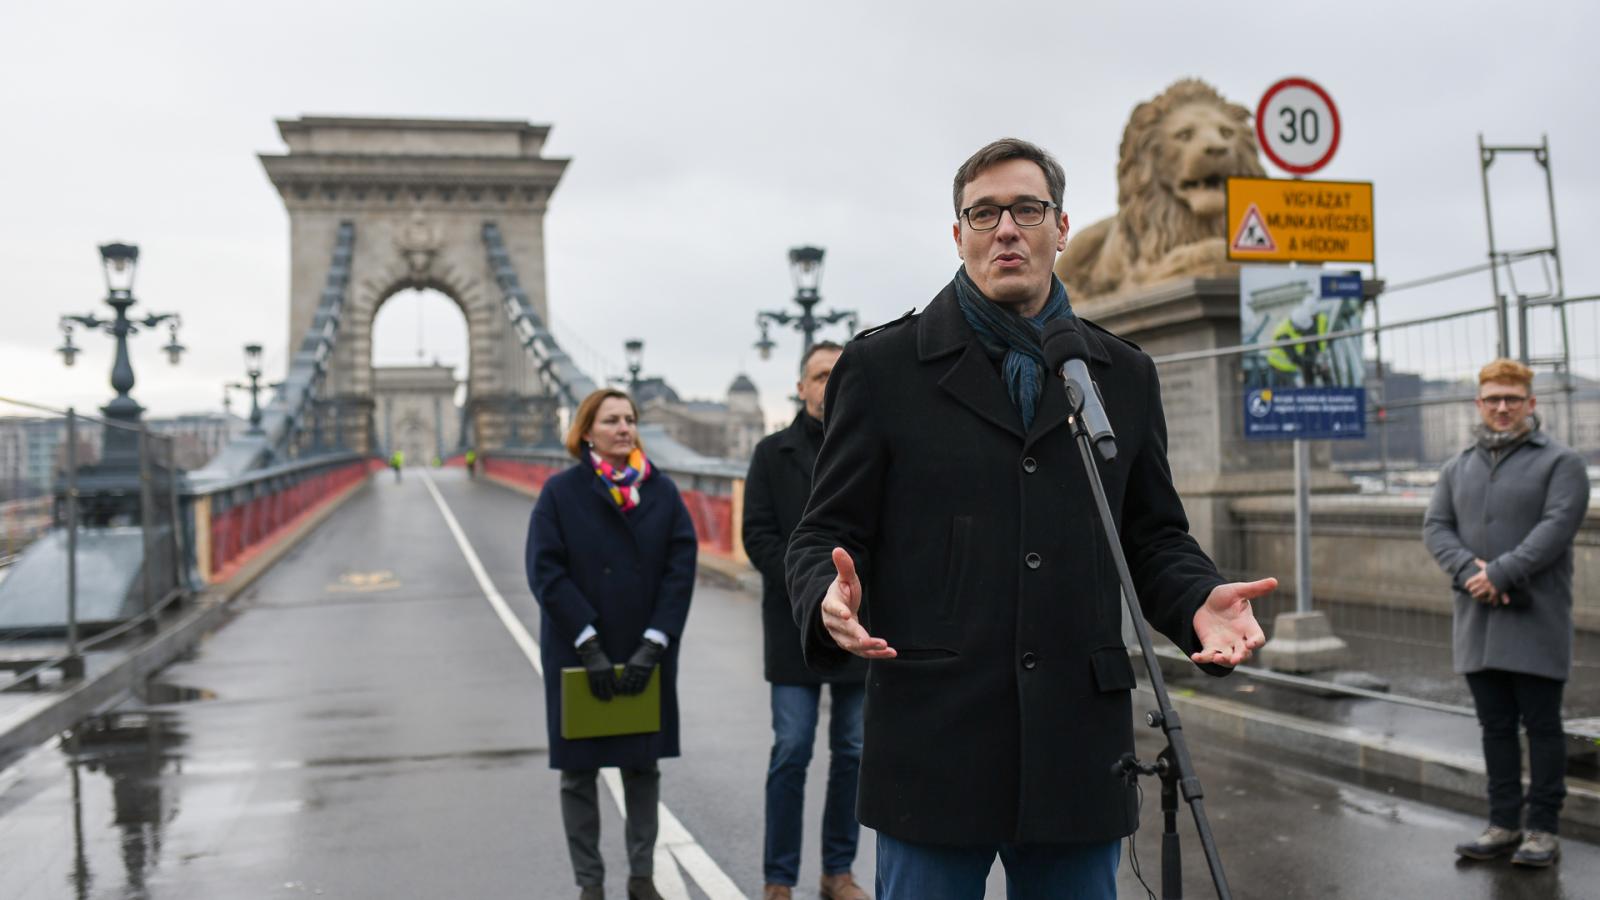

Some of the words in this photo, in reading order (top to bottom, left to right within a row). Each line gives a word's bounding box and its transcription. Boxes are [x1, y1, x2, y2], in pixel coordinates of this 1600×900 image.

[1280, 107, 1319, 144] 30
[1283, 190, 1351, 208] VIGYÁZAT
[1267, 213, 1369, 232] MUNKAVÉGZÉS
[1288, 236, 1298, 252] A
